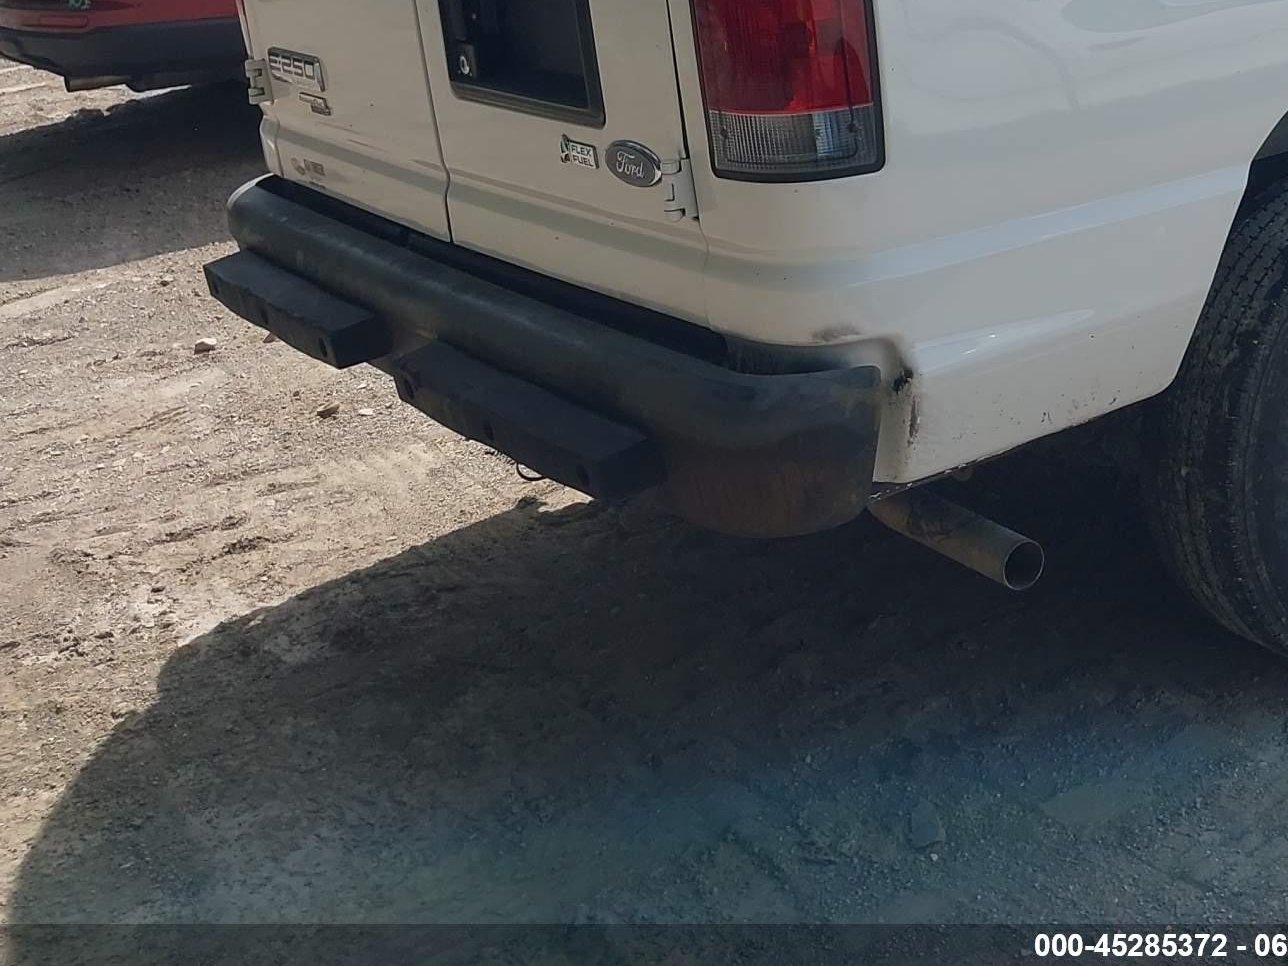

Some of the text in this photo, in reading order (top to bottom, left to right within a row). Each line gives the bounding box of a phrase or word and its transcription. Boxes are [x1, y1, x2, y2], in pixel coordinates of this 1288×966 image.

[570, 144, 592, 157] FLEX
[572, 154, 595, 168] FUEL
[615, 150, 646, 179] Ford
